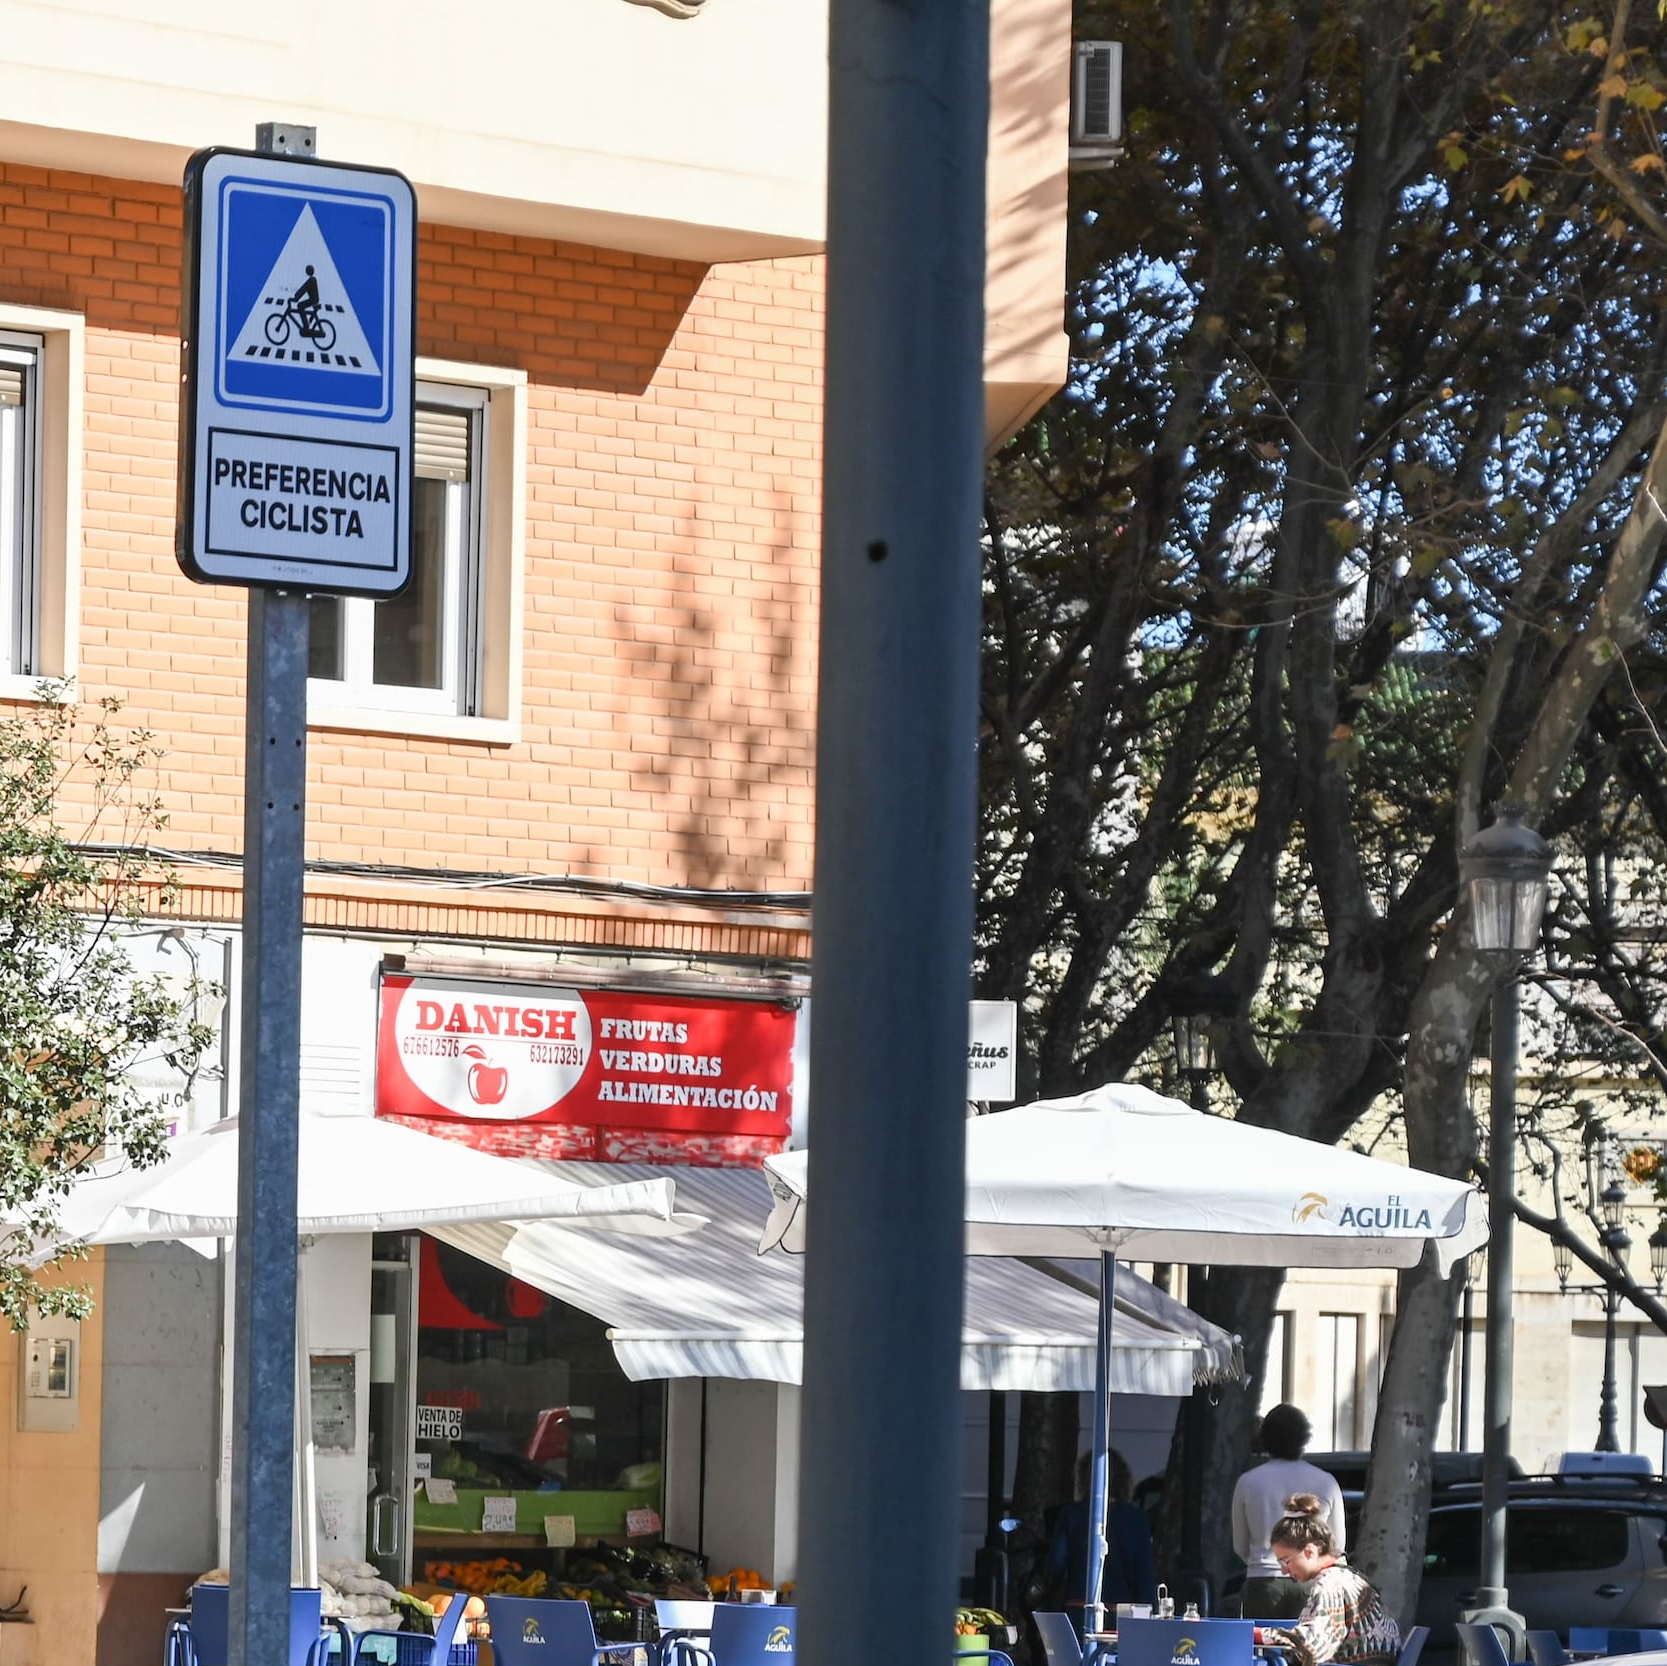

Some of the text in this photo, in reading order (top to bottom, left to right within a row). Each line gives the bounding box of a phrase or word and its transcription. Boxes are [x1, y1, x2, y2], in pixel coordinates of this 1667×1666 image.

[215, 458, 390, 503] PREFERENCIA
[240, 499, 364, 538] CICLISTA
[415, 1000, 577, 1041] DANISH
[600, 1018, 688, 1044] FRUTAS
[404, 1036, 460, 1058] 676612576
[530, 1045, 584, 1066] 632173291
[599, 1049, 722, 1077] VERDURAS
[598, 1080, 779, 1112] ALIMENTACIÓN
[1388, 1195, 1401, 1206] EL
[1339, 1203, 1432, 1229] ÁGUILA
[418, 1408, 462, 1424] VENTA DE
[418, 1424, 460, 1439] HIELO
